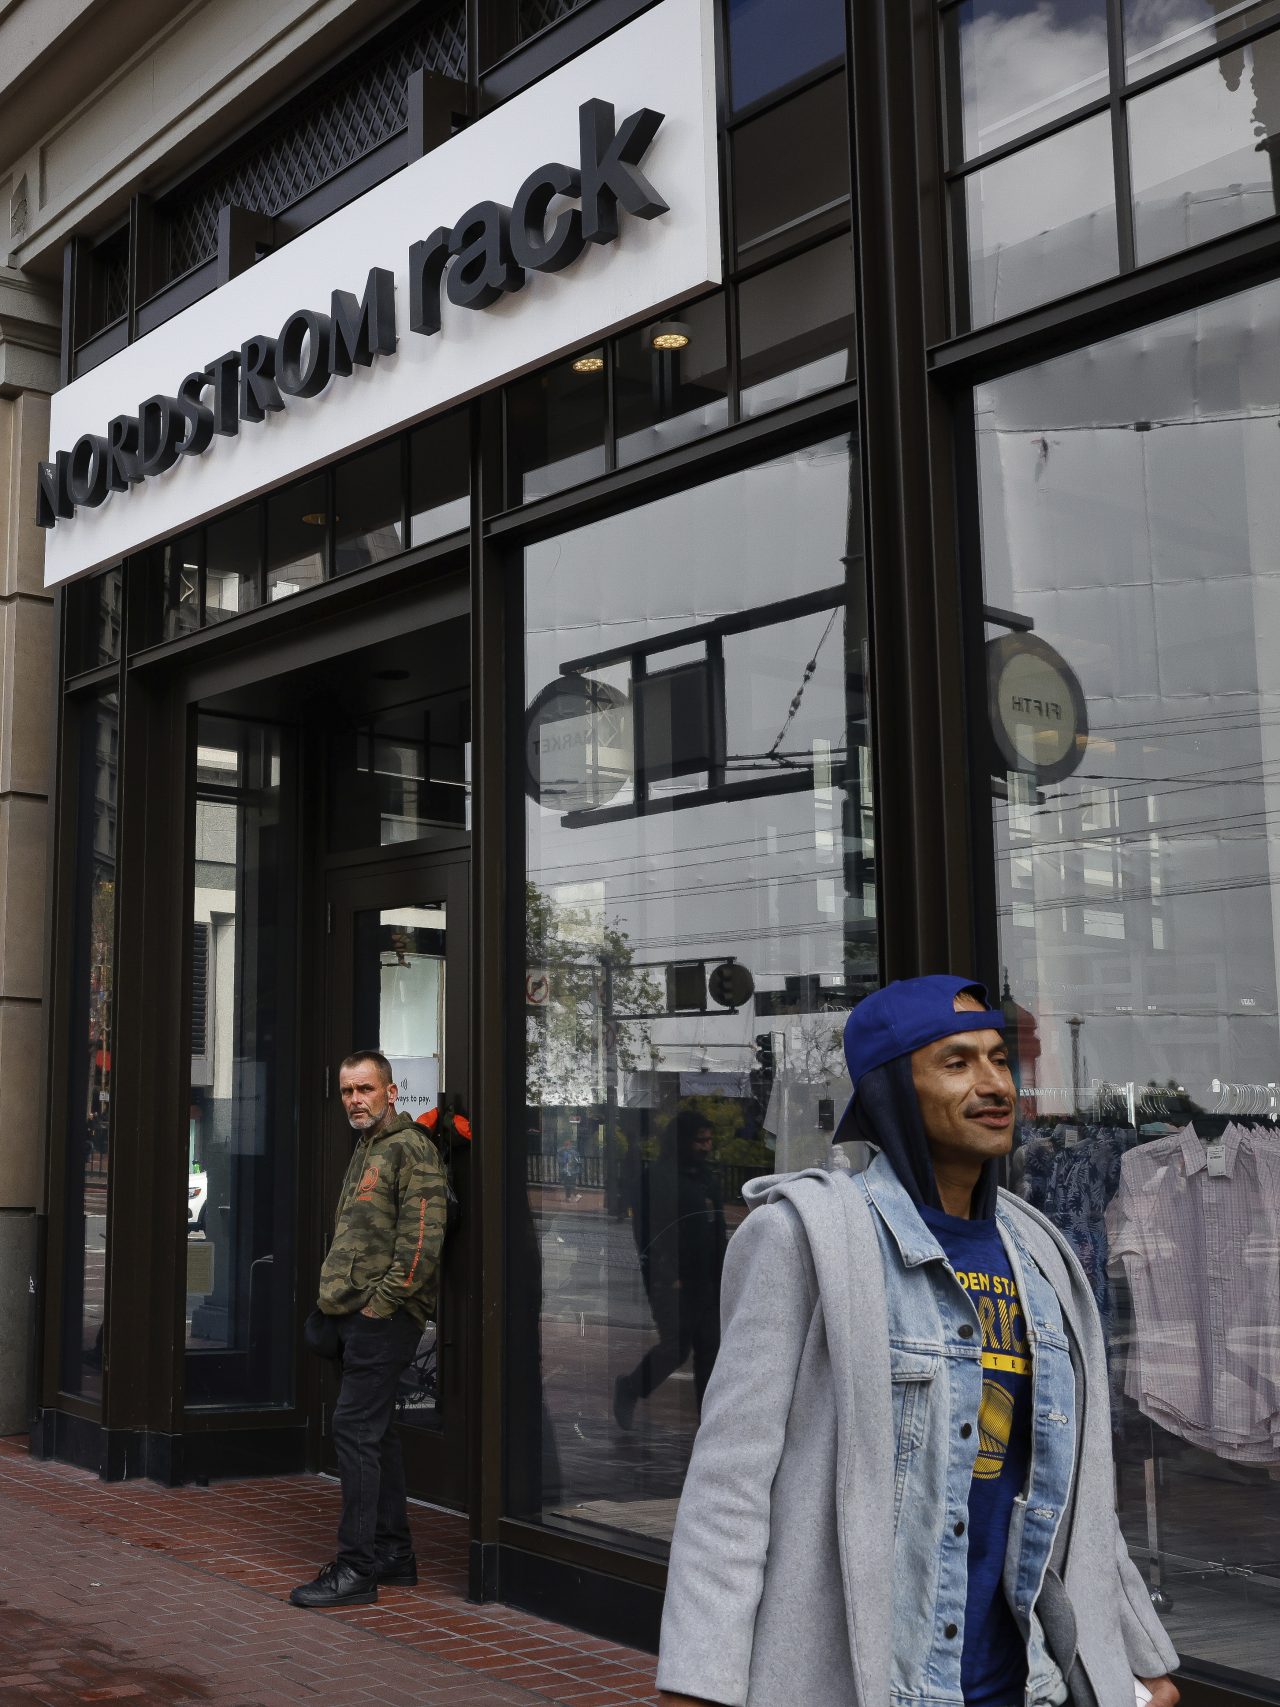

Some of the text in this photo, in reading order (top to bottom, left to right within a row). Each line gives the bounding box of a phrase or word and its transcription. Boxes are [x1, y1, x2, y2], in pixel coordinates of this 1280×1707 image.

[35, 97, 671, 529] NORDSTROM rack
[411, 1094, 417, 1102] to
[955, 1271, 1018, 1297] DEN STA
